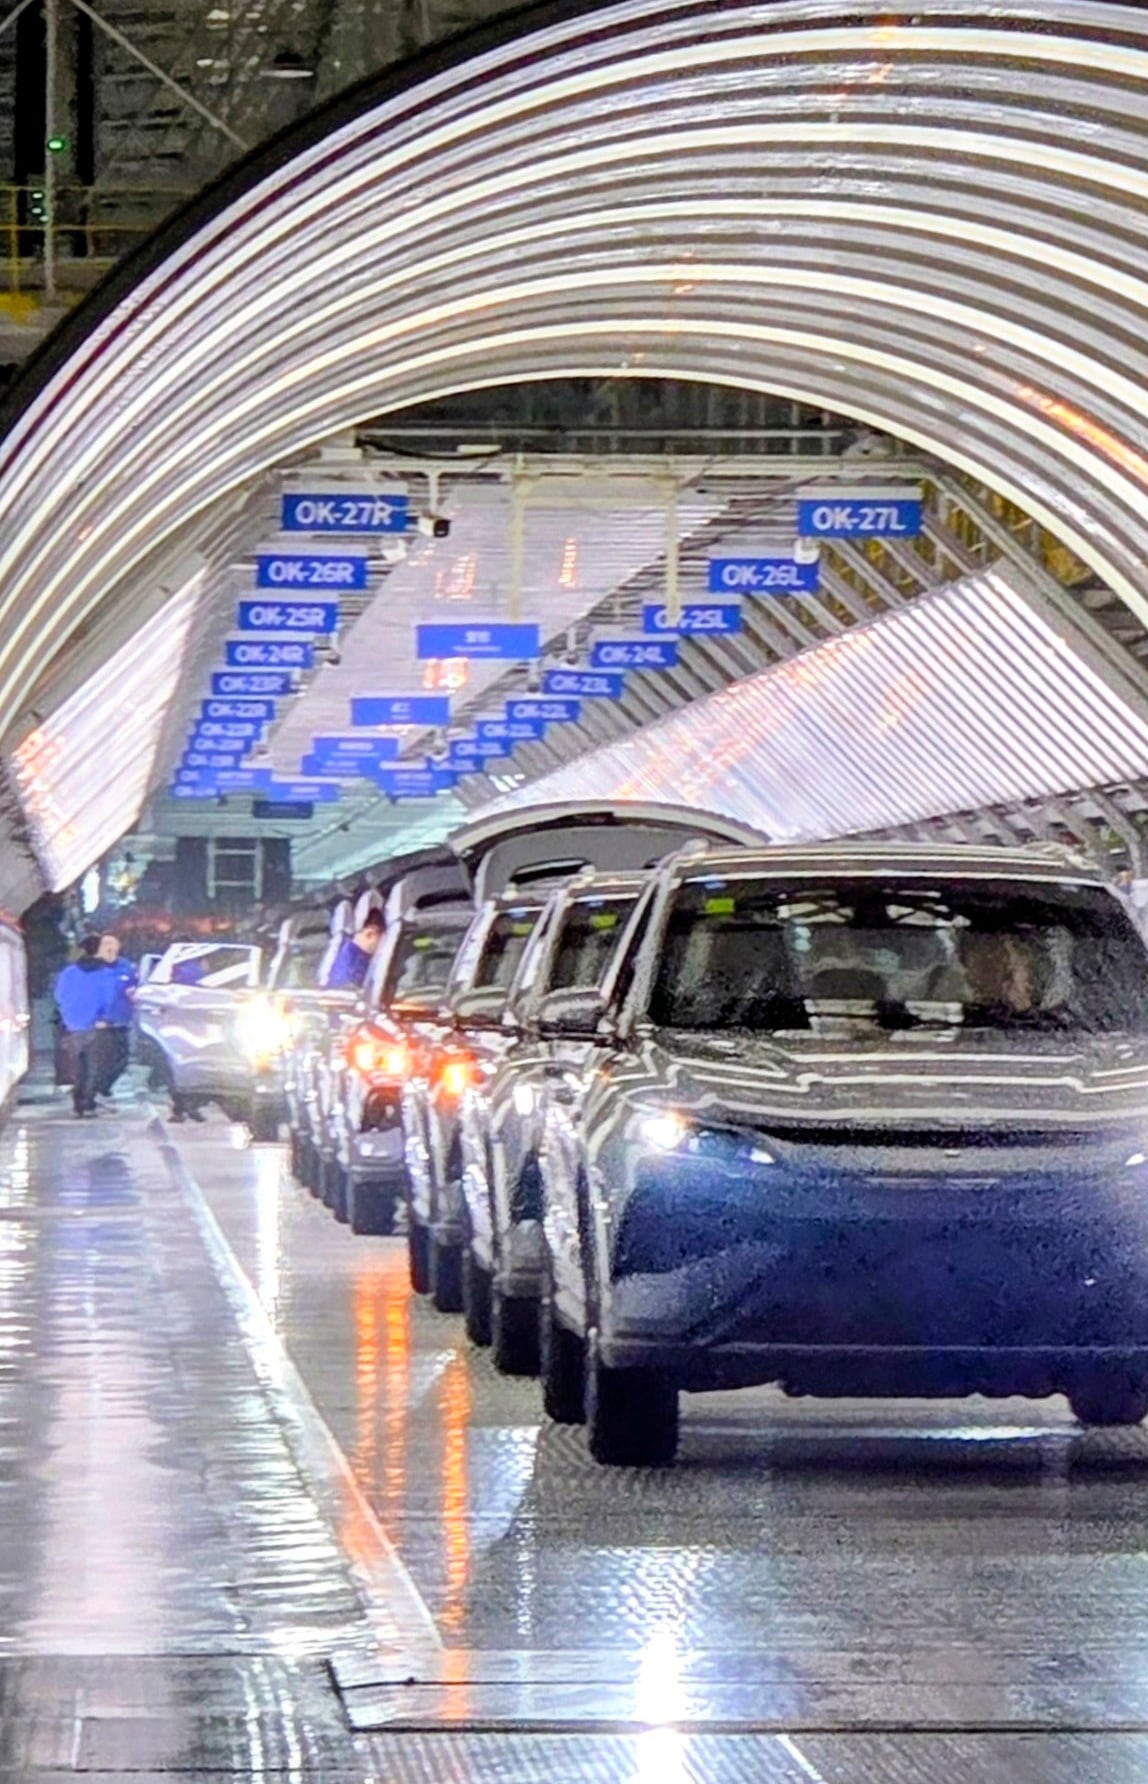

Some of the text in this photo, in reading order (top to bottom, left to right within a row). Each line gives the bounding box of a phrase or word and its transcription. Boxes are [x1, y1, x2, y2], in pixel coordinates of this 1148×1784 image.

[295, 500, 392, 525] OK-27R
[812, 507, 906, 530] OK-27L
[722, 565, 804, 586] OK-26L
